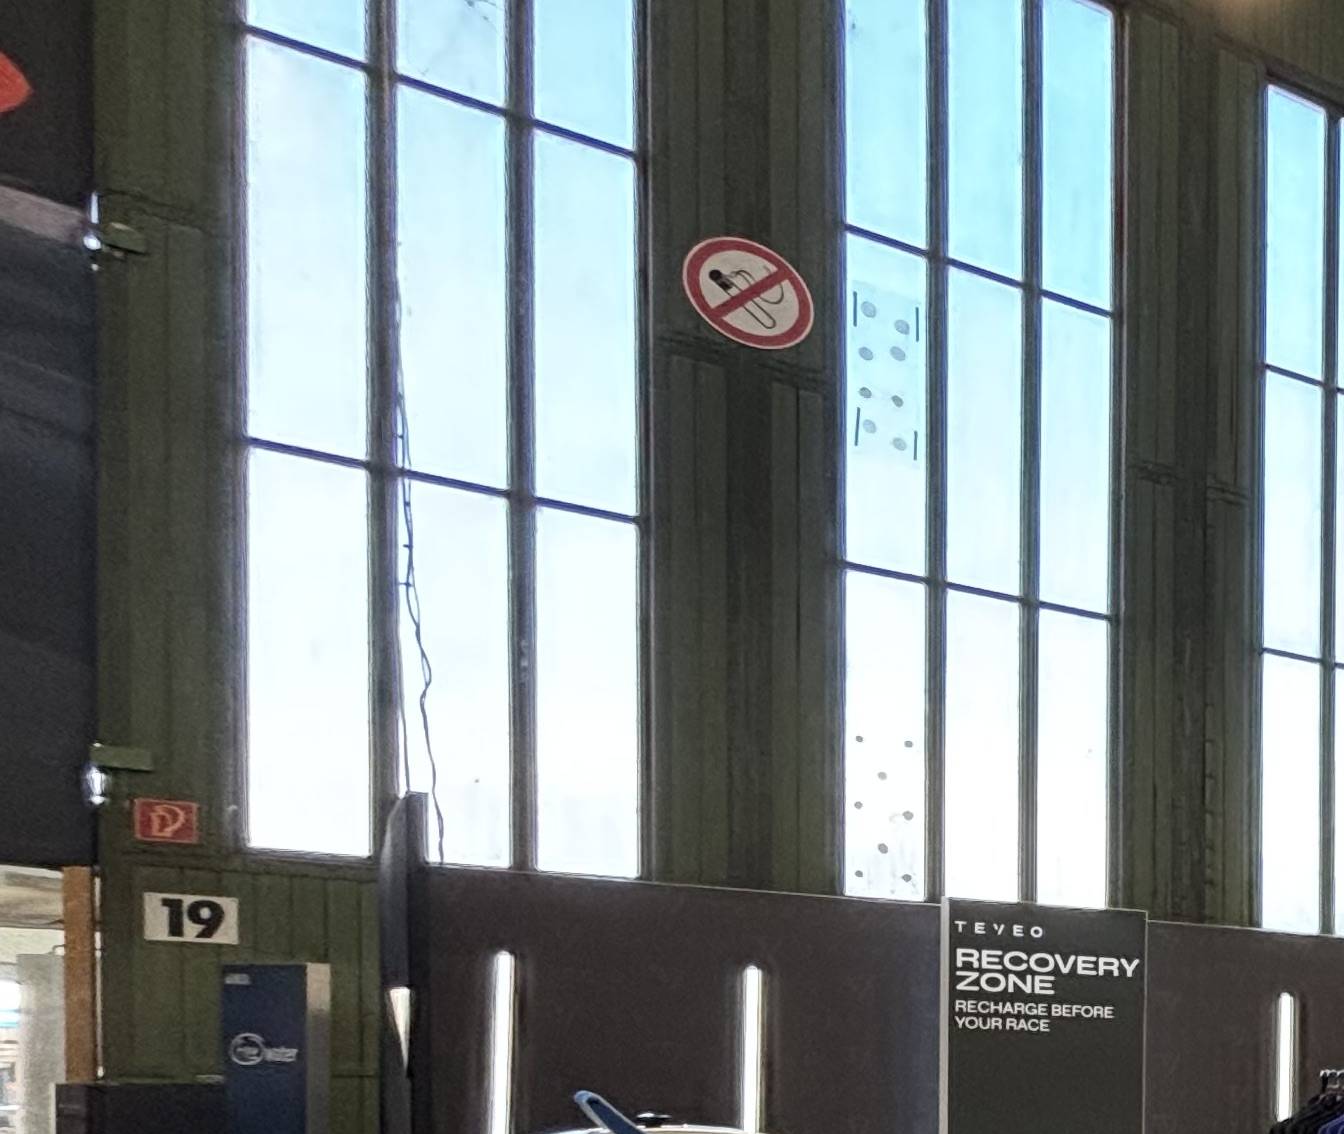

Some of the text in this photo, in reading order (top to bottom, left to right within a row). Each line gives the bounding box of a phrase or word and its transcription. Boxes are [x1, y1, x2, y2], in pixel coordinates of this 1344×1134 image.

[161, 898, 225, 939] 19
[954, 920, 1044, 938] TEVEO
[956, 948, 1140, 978] RECOVERY
[955, 971, 1055, 995] ZONE
[955, 1000, 1115, 1019] RECHARGE BEFORE
[954, 1016, 1050, 1032] YOUR RACE
